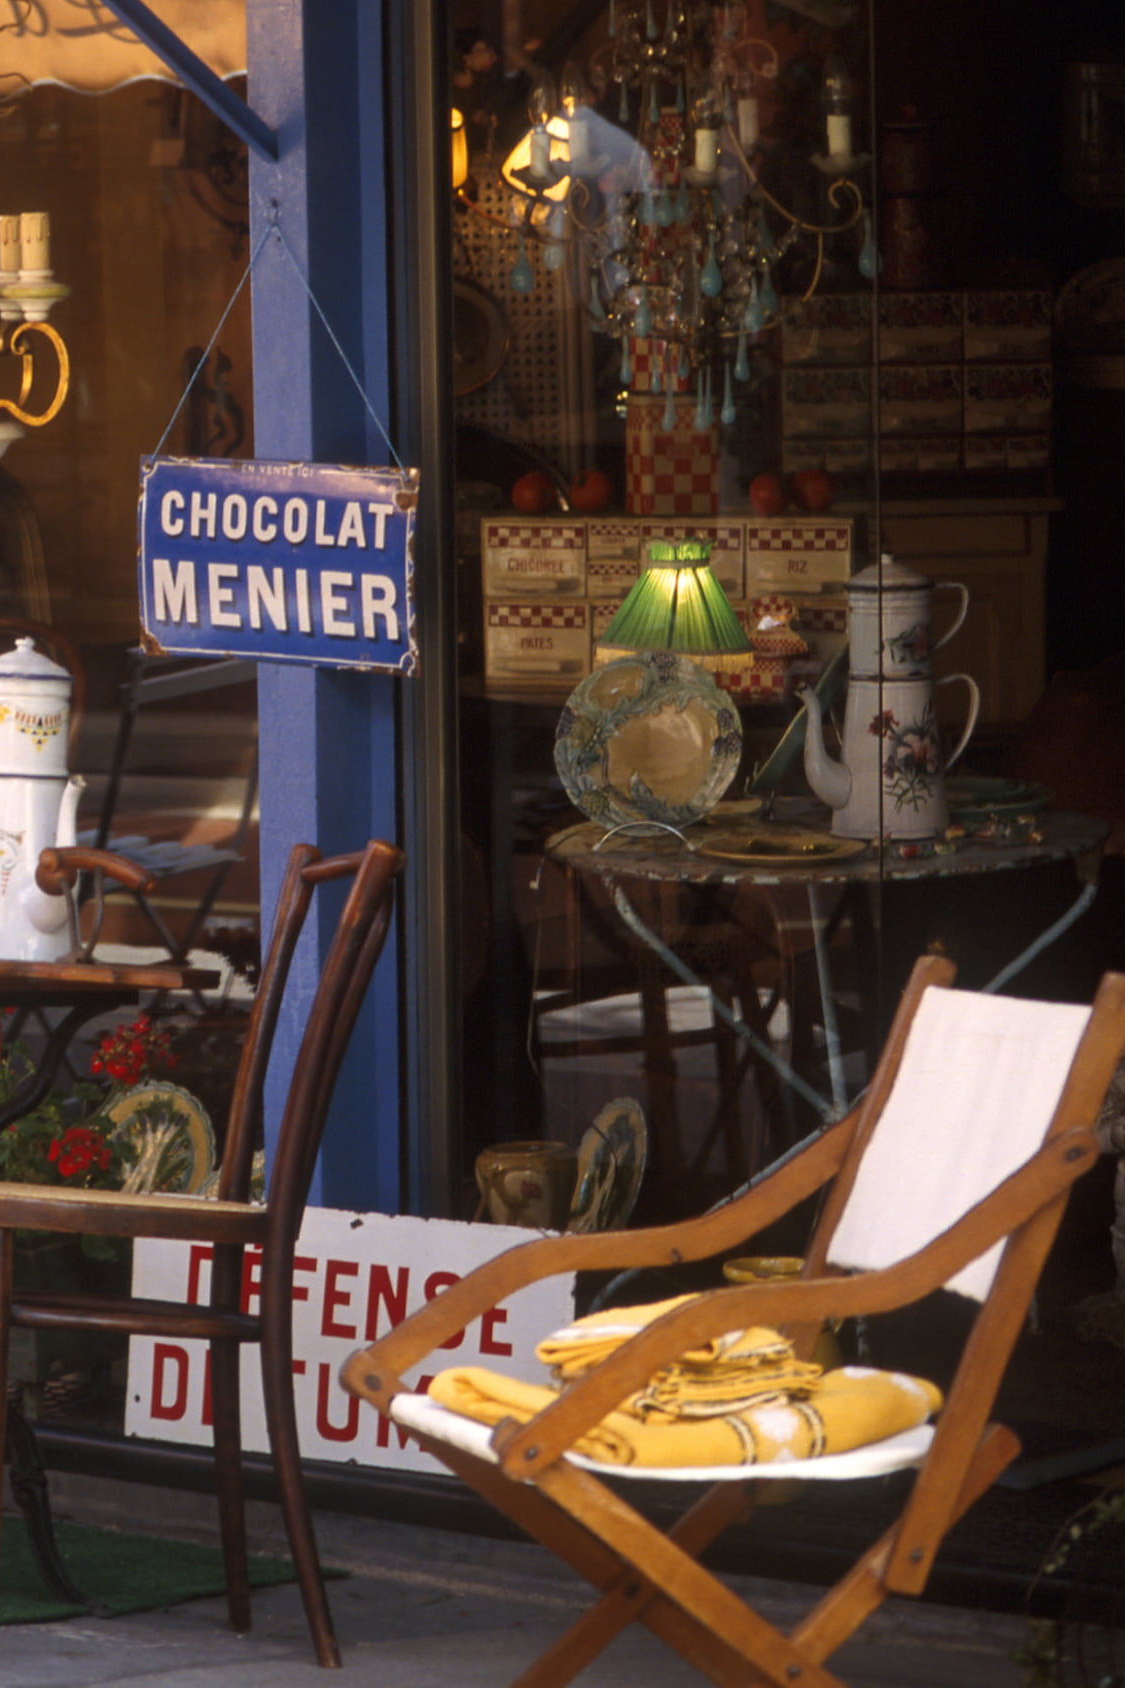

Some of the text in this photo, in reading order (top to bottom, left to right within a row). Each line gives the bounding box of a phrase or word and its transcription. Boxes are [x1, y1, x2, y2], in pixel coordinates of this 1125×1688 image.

[161, 489, 395, 550] CHOCOLAT
[152, 558, 400, 641] MENIER
[788, 559, 809, 574] RIZ
[150, 1342, 213, 1427] D
